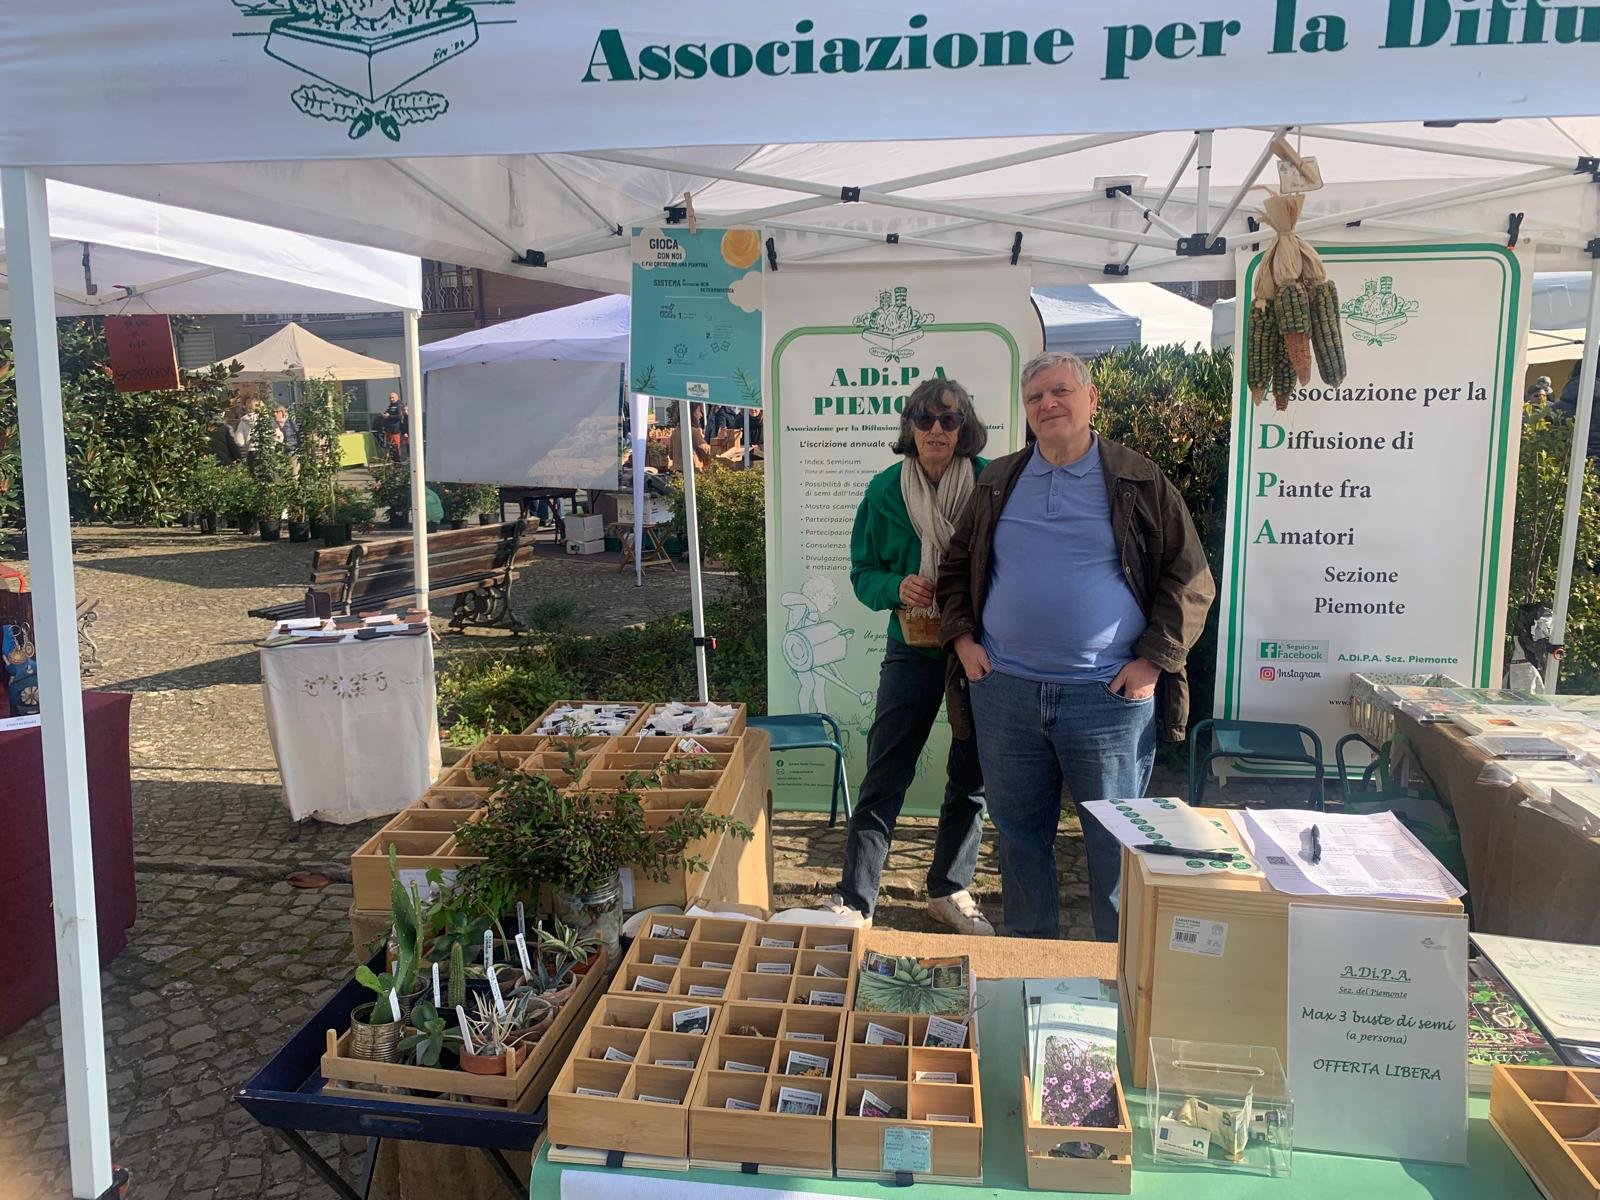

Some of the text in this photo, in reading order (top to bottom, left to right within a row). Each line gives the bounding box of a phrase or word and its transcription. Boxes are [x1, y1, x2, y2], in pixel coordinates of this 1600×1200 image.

[581, 0, 1600, 83] Associazione per la Diffu
[649, 238, 679, 250] GIOCA
[657, 252, 683, 260] CON NOI
[653, 279, 681, 287] SISTEMA
[1423, 385, 1461, 406] per
[1467, 381, 1487, 401] la
[785, 424, 834, 432] Associazione
[800, 440, 848, 448] L'iscrizione
[850, 440, 886, 448] annuale
[1258, 424, 1414, 450] Diffusione di
[805, 480, 841, 488] Possibilità
[1256, 472, 1372, 498] Piante fra
[1253, 519, 1355, 546] Amatori
[1324, 566, 1398, 583] Sezione
[1314, 597, 1406, 615] Piemonte
[1278, 650, 1322, 660] Facebook
[1385, 654, 1405, 663] Sez.
[1408, 655, 1459, 664] Piemonte
[1277, 668, 1322, 681] Instagram
[1339, 986, 1408, 998] Sez. del Piemonte
[1302, 1006, 1457, 1031] Max 3 buste di semi
[1346, 1030, 1408, 1045] (a persona)
[1313, 1059, 1442, 1080] OFFERTA LIBERA
